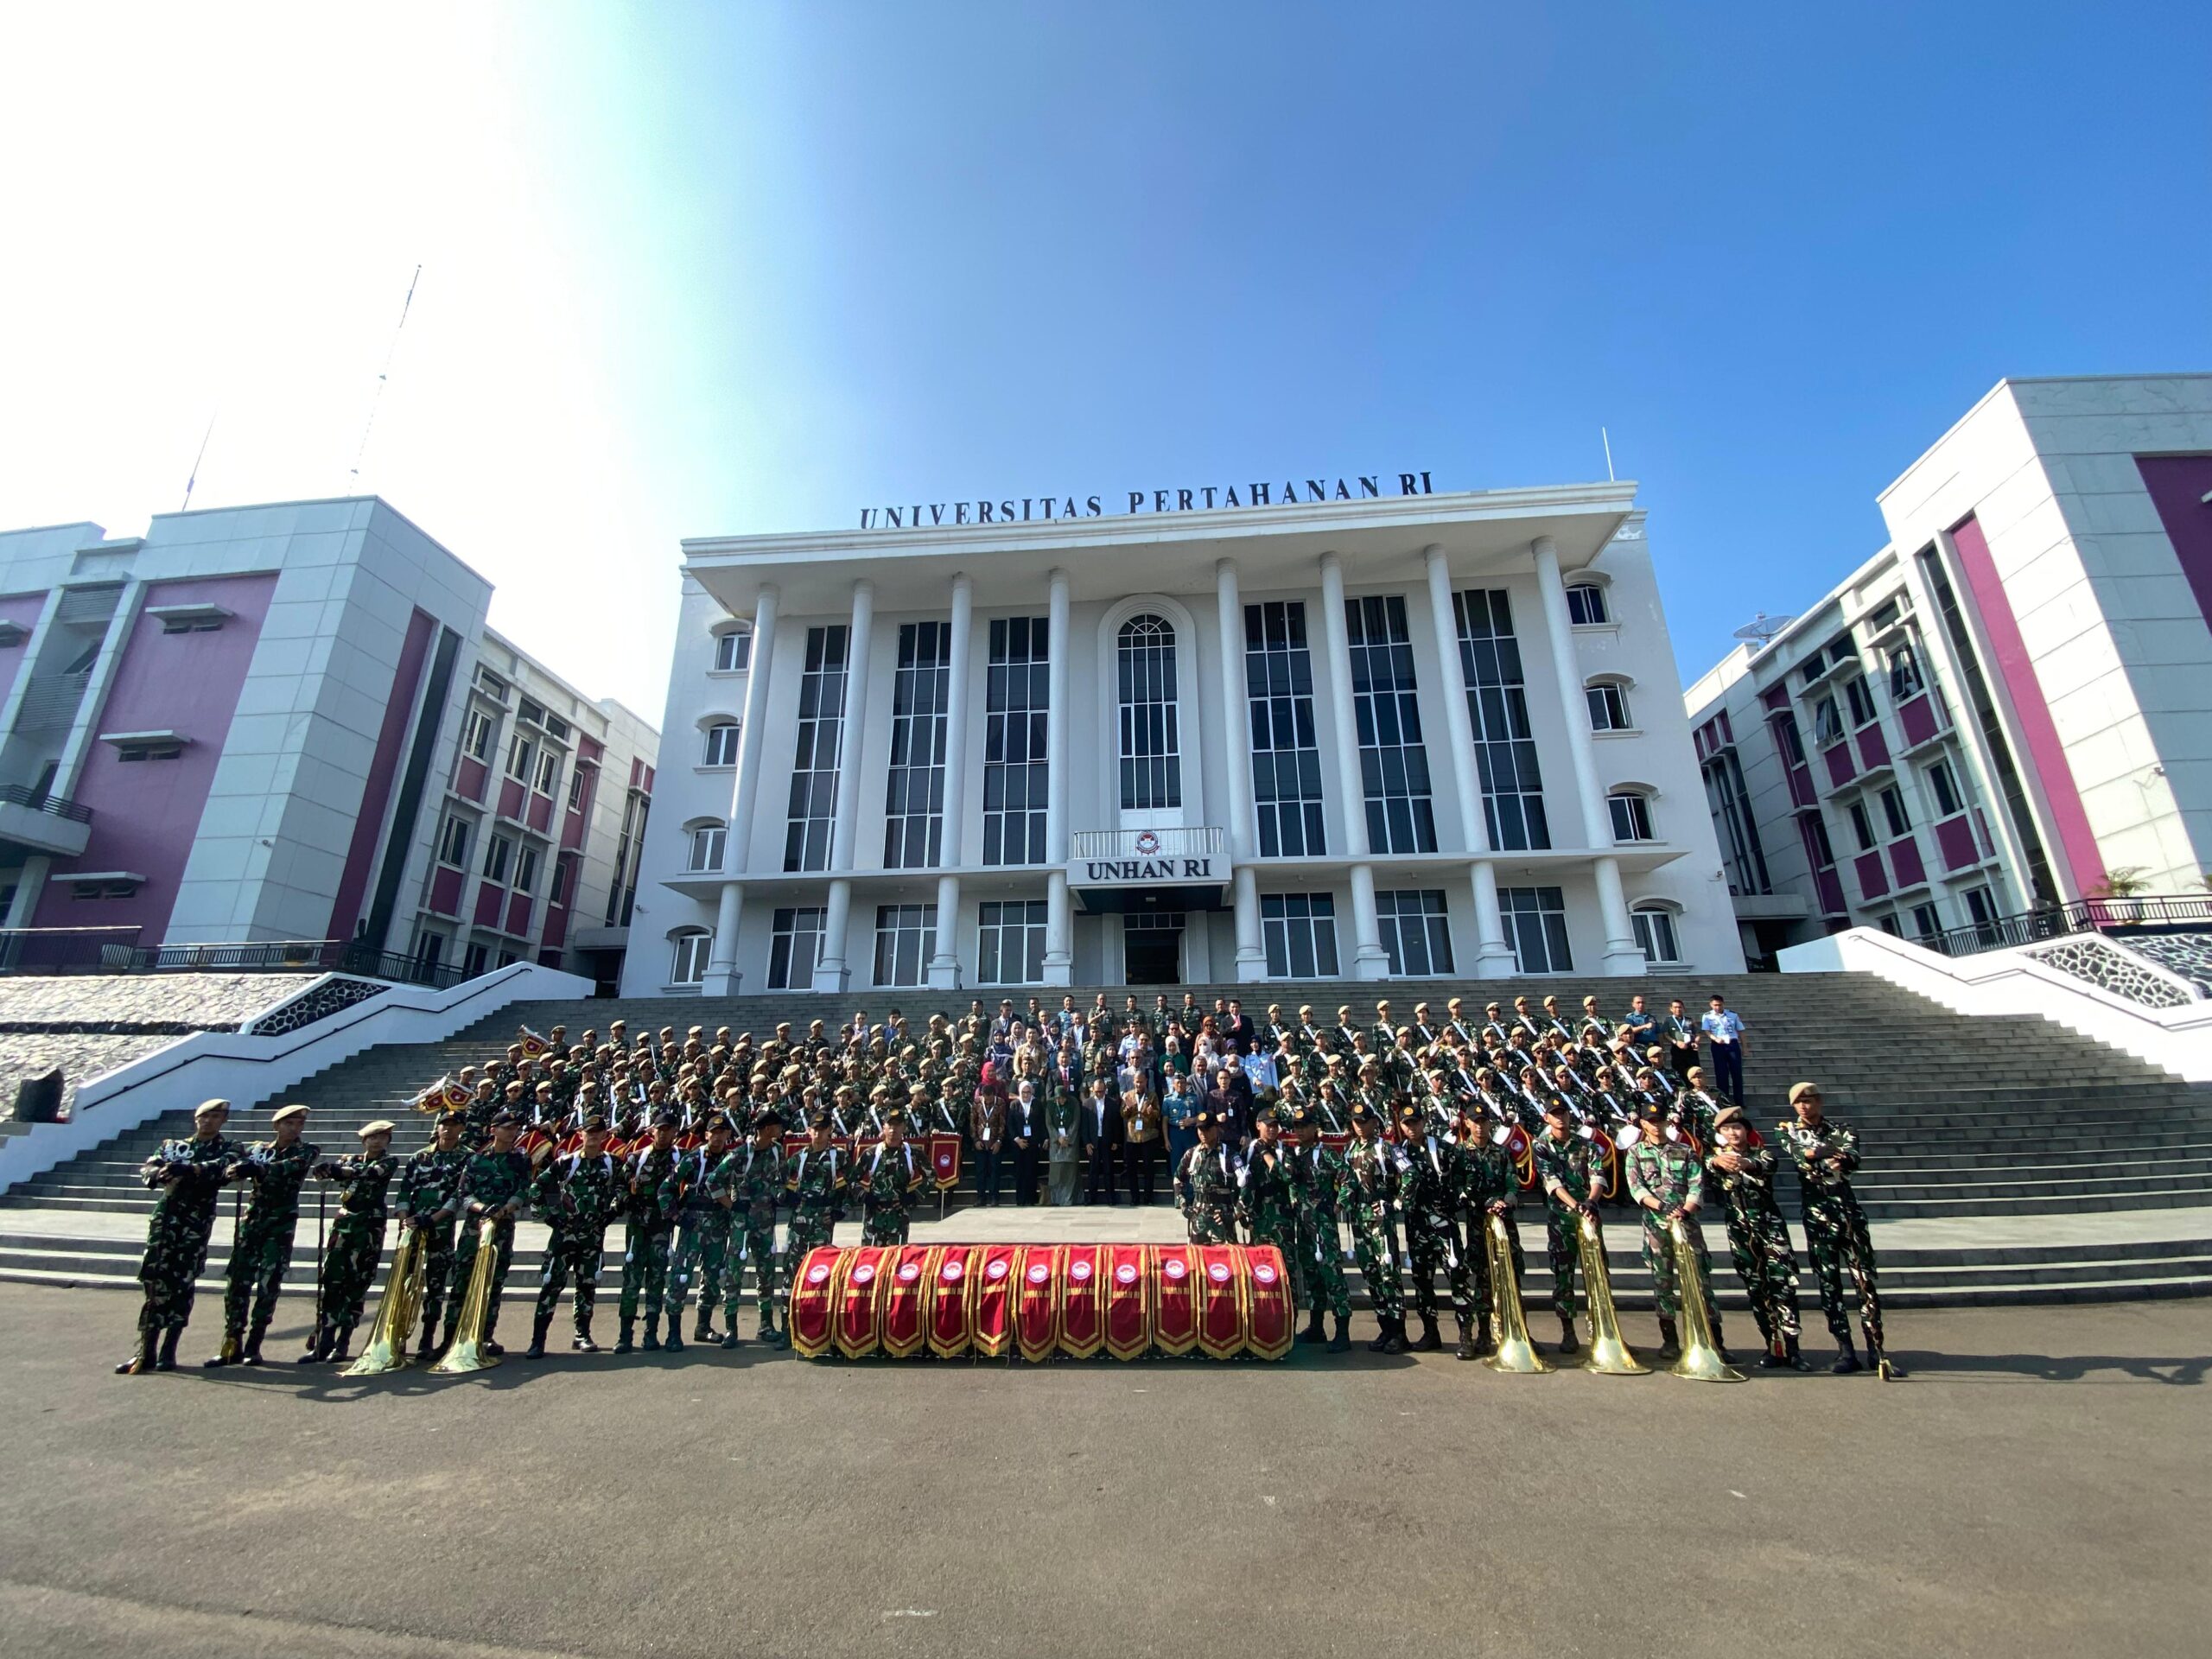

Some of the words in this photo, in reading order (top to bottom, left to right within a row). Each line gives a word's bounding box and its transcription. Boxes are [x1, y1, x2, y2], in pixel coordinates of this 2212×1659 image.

[861, 495, 1102, 530] UNIVERSITAS
[1128, 476, 1379, 514] PERTAHANAN
[1398, 472, 1432, 495] RI
[1086, 860, 1174, 880] UNHAN
[1183, 859, 1211, 876] RI
